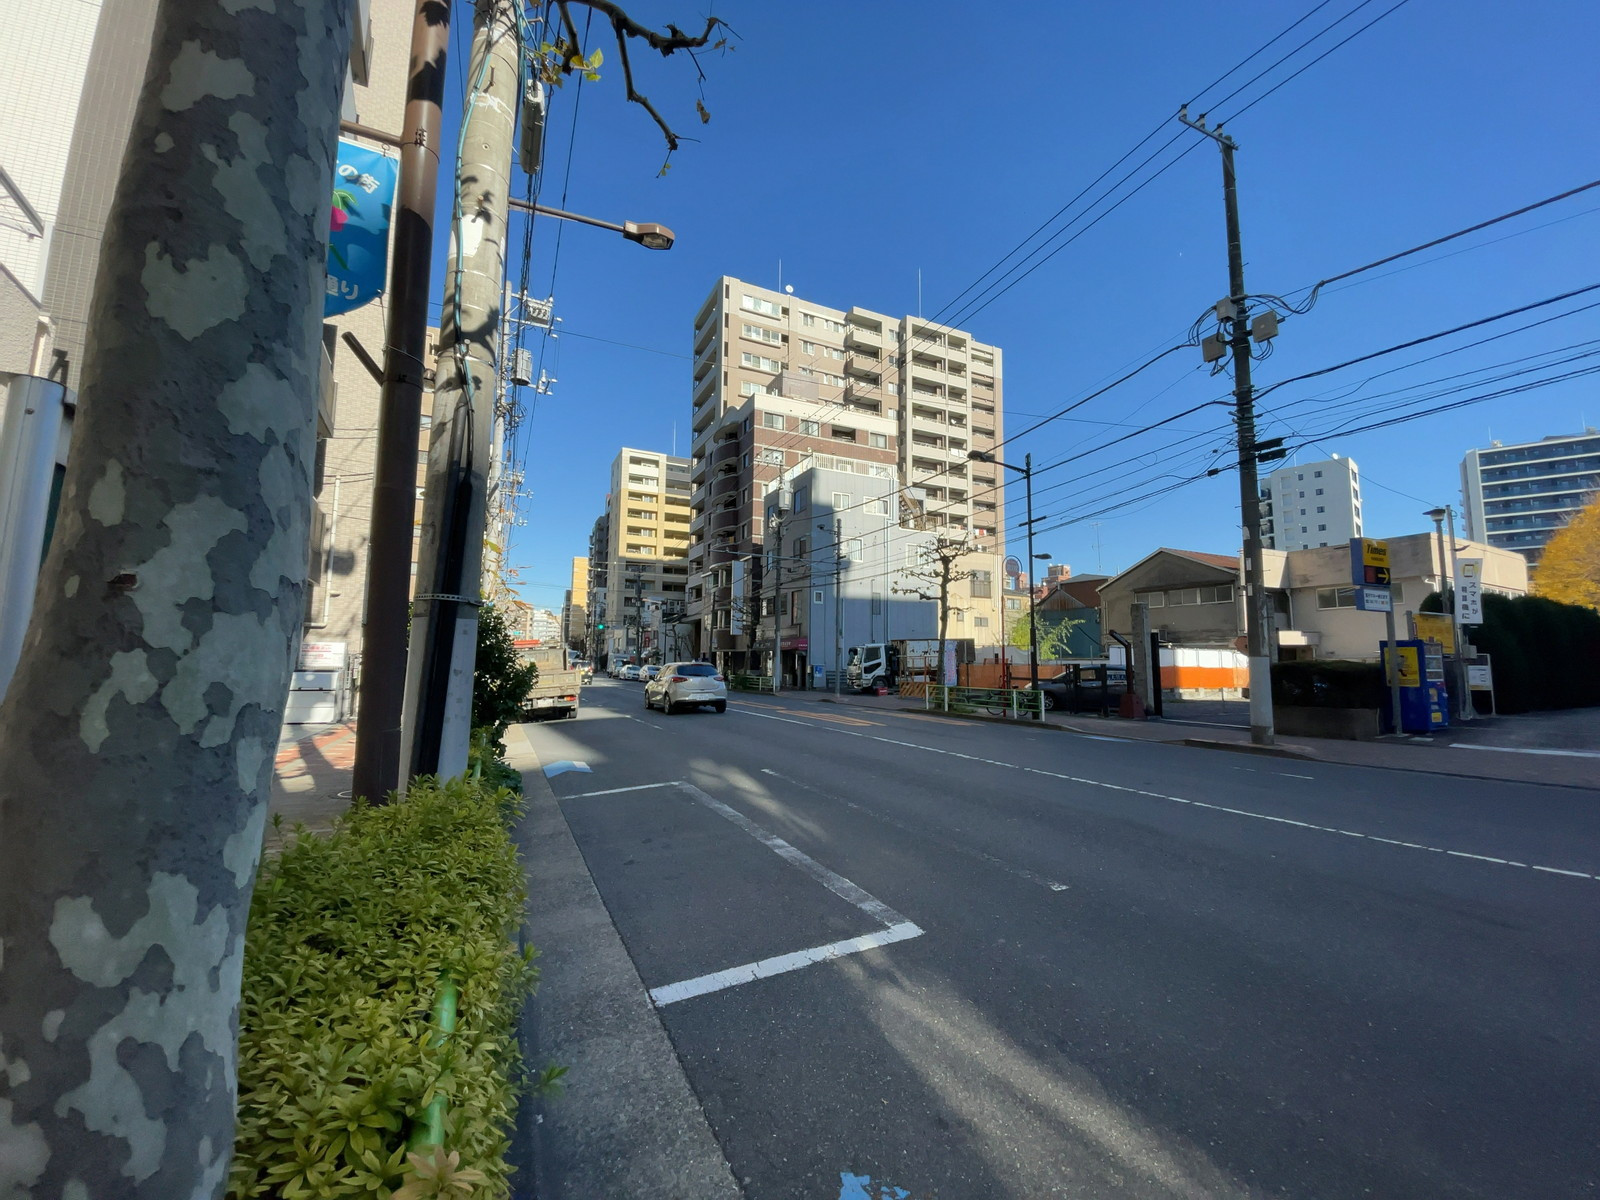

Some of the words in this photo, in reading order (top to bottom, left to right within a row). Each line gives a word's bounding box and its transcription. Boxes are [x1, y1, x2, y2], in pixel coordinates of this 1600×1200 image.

[1366, 544, 1387, 556] Times
[1469, 581, 1478, 615] スマホが
